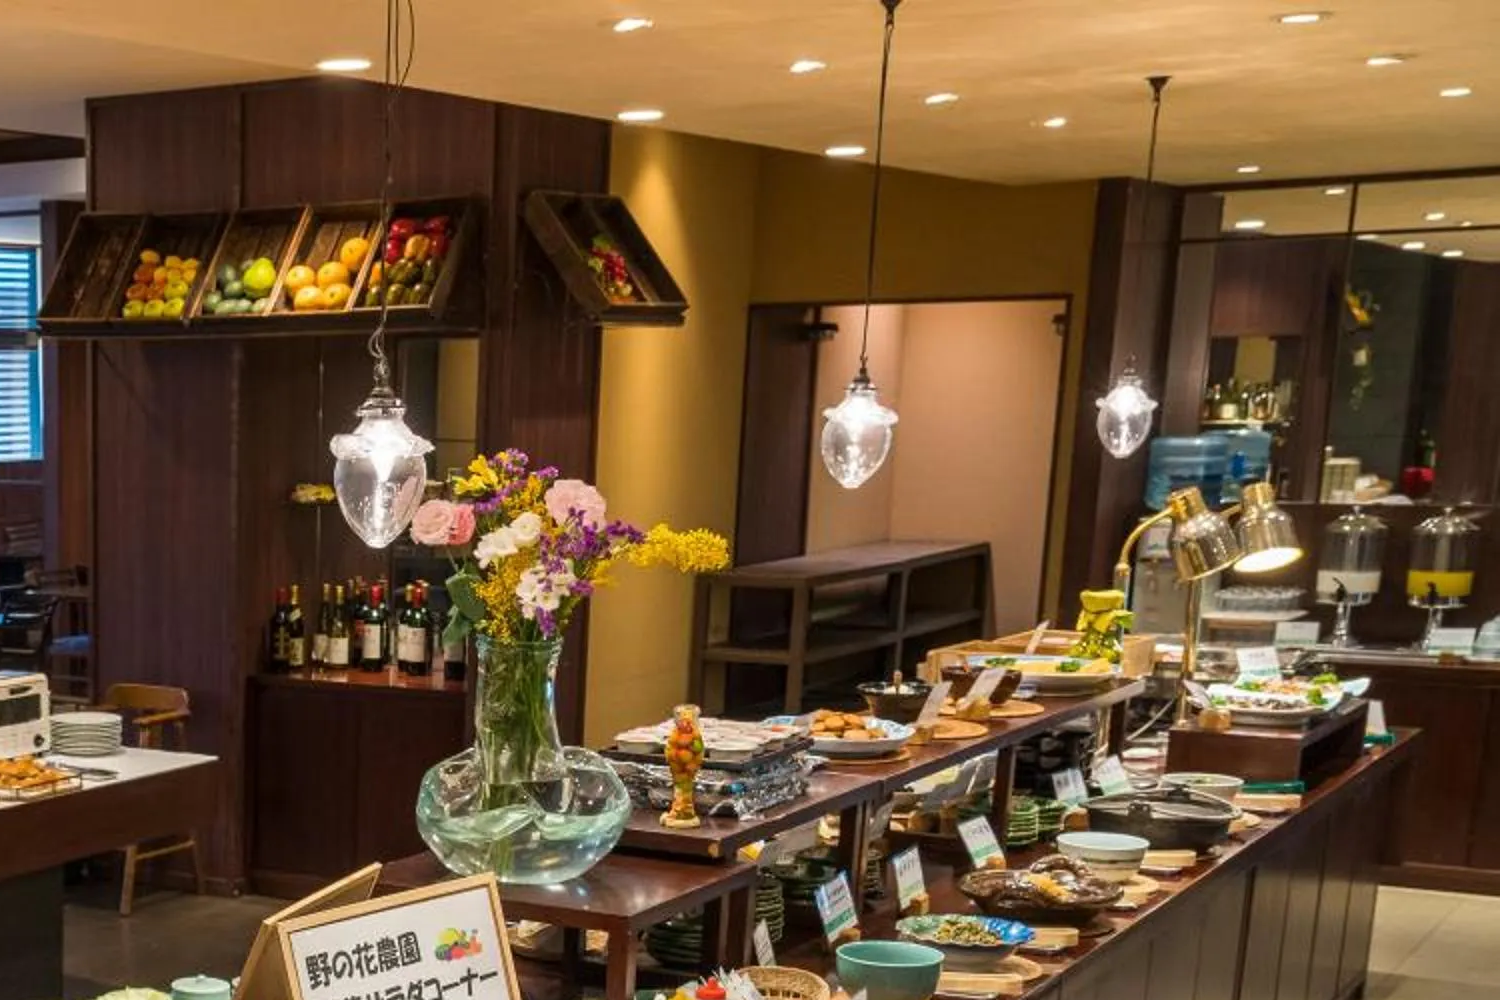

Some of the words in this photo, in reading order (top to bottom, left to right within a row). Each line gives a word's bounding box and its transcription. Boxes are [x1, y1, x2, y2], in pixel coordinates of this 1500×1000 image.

[305, 931, 422, 989] 野の花農園
